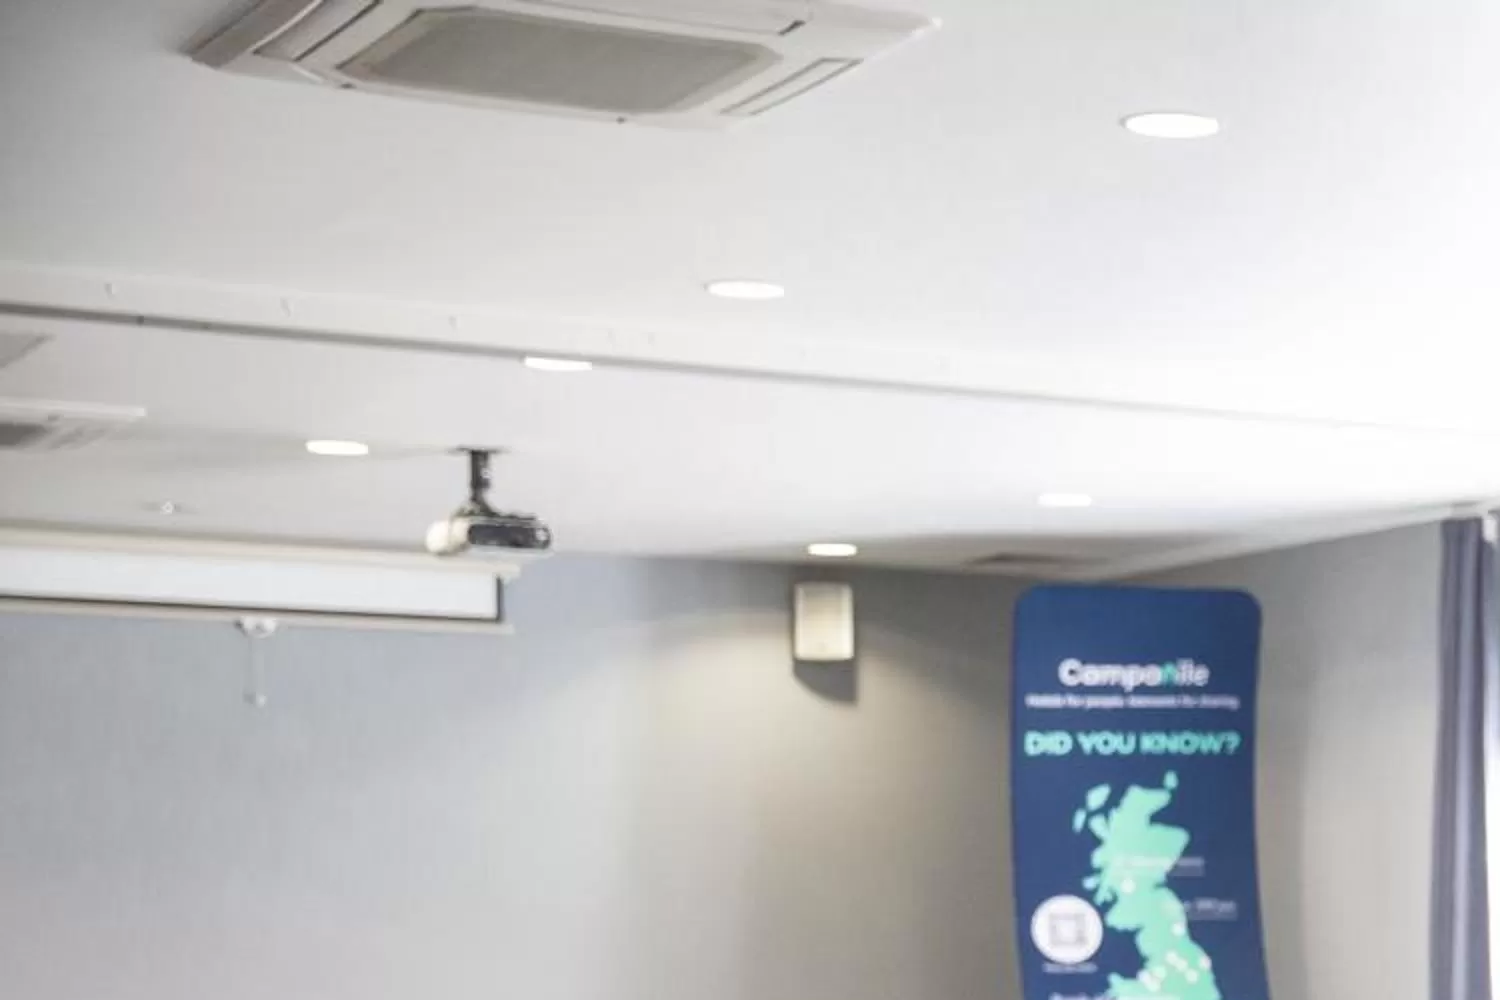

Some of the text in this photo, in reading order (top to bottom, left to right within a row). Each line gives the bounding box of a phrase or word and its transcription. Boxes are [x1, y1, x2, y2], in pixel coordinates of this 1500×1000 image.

[1025, 731, 1241, 756] DID YOU KNOW?
